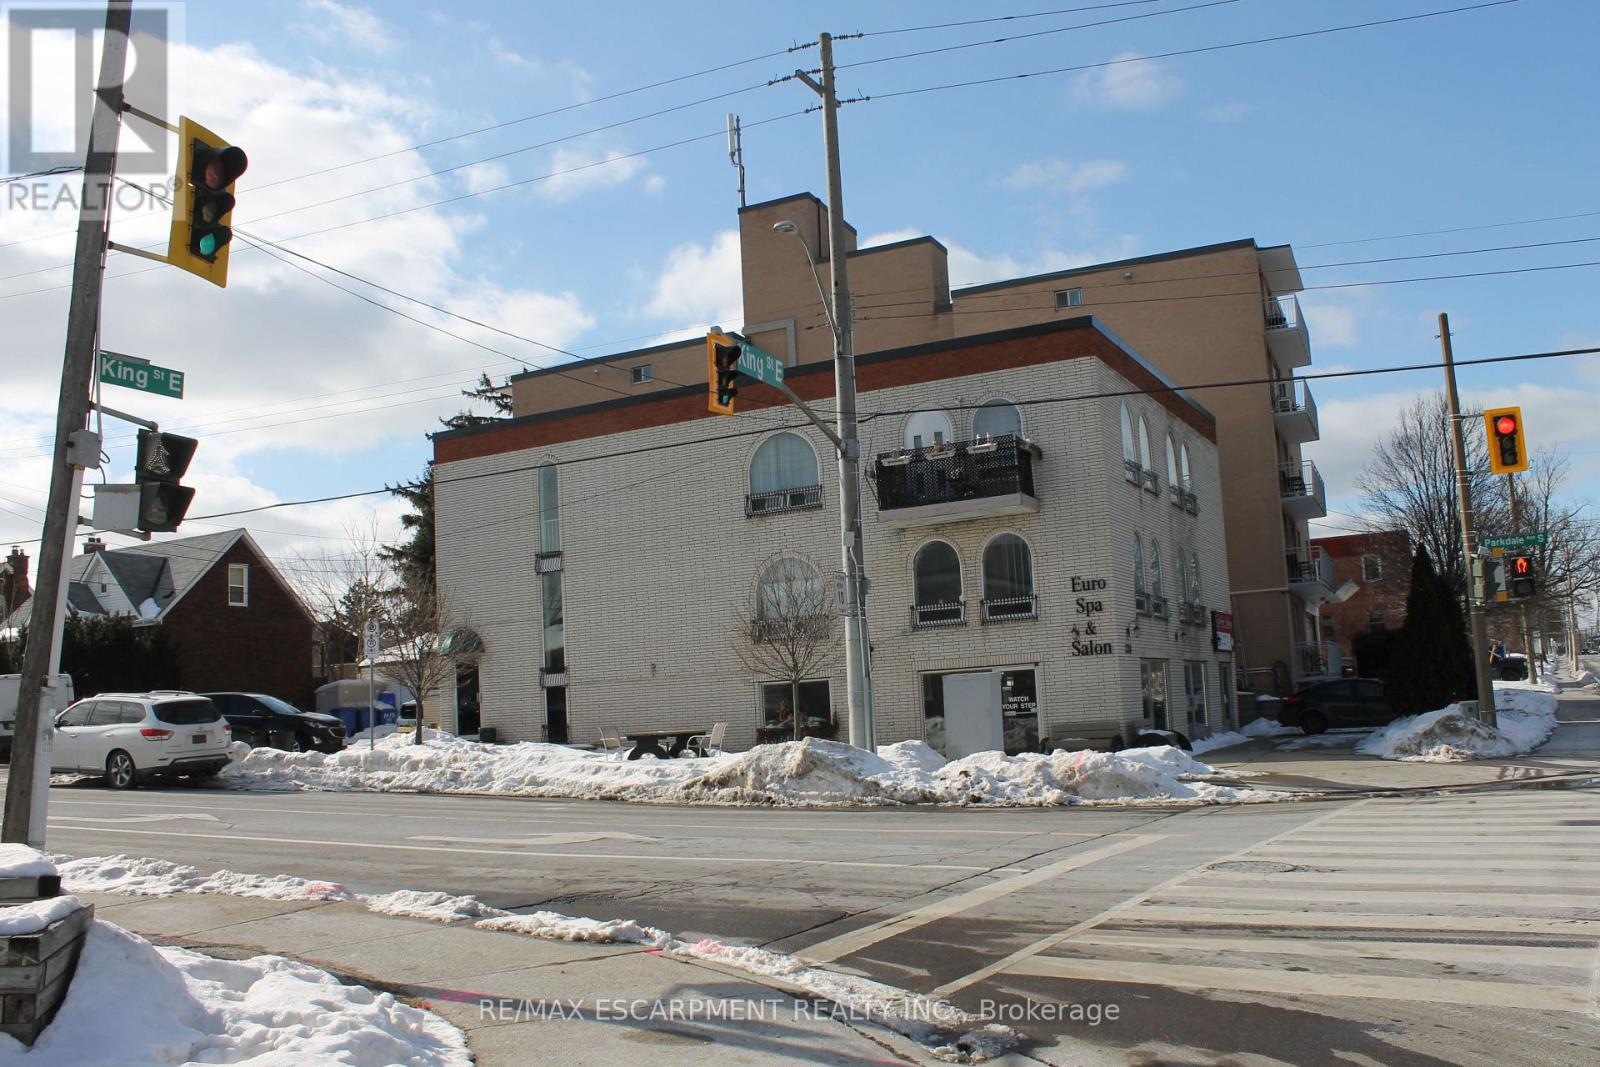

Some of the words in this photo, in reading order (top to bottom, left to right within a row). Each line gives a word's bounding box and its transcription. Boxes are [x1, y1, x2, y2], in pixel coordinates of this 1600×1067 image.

[738, 344, 764, 381] King
[766, 355, 774, 371] St
[775, 359, 784, 383] E
[102, 357, 148, 389] King
[153, 369, 165, 381] St
[168, 372, 181, 392] E
[1484, 536, 1525, 547] Parkdale
[1537, 534, 1544, 543] S
[1071, 576, 1106, 593] Euro
[1076, 597, 1103, 617] Spa
[1085, 620, 1097, 636] &
[1072, 639, 1113, 657] Salon
